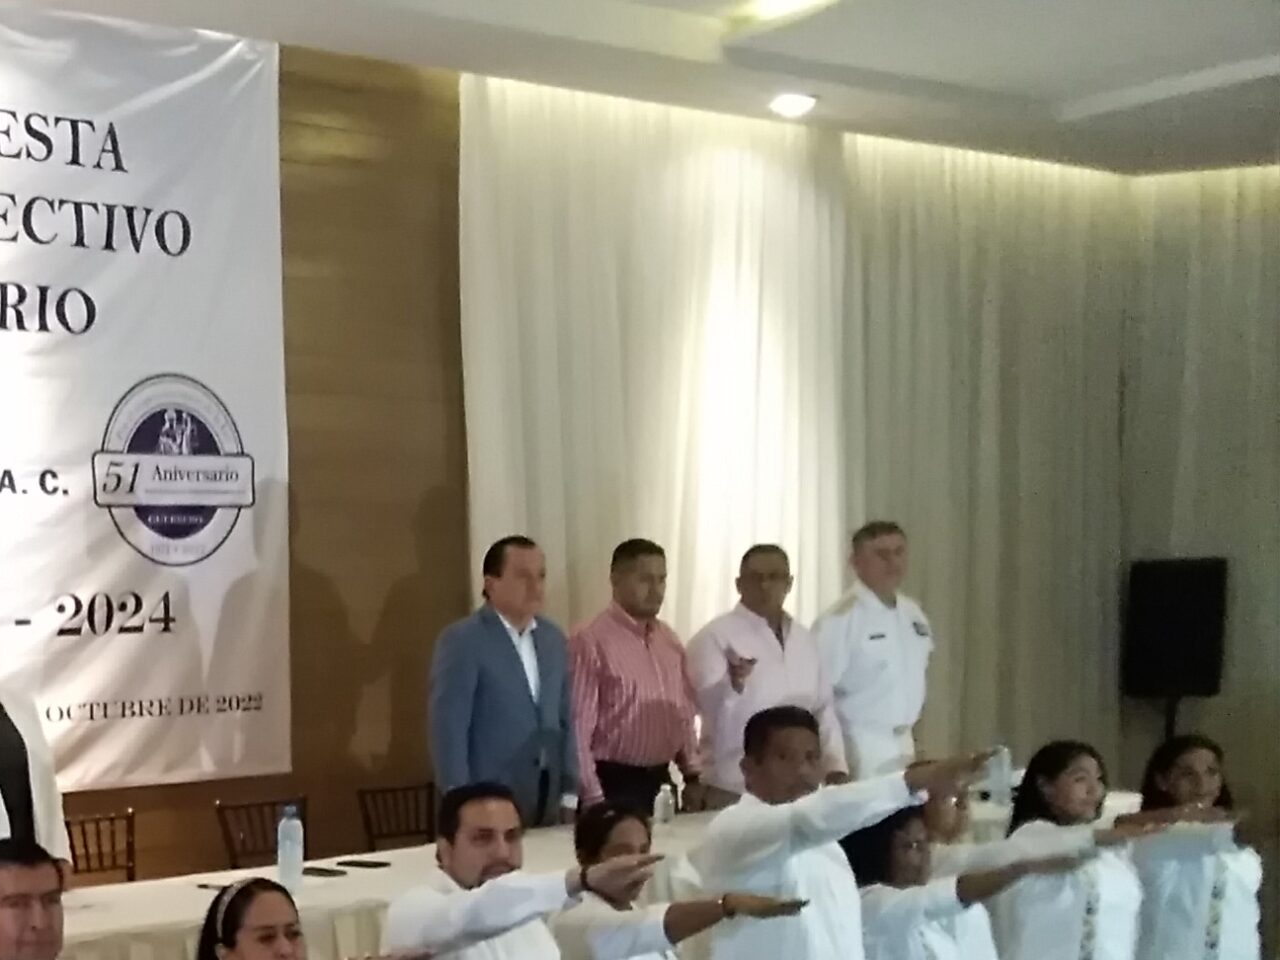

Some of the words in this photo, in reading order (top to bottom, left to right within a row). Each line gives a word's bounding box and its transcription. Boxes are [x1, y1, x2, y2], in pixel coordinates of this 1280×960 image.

[38, 467, 69, 496] C.
[102, 460, 140, 495] 51
[152, 464, 239, 484] Aniversario
[55, 590, 177, 637] 2024
[45, 696, 172, 723] OCTUBRE
[178, 692, 211, 717] DE
[215, 691, 263, 714] 2022
